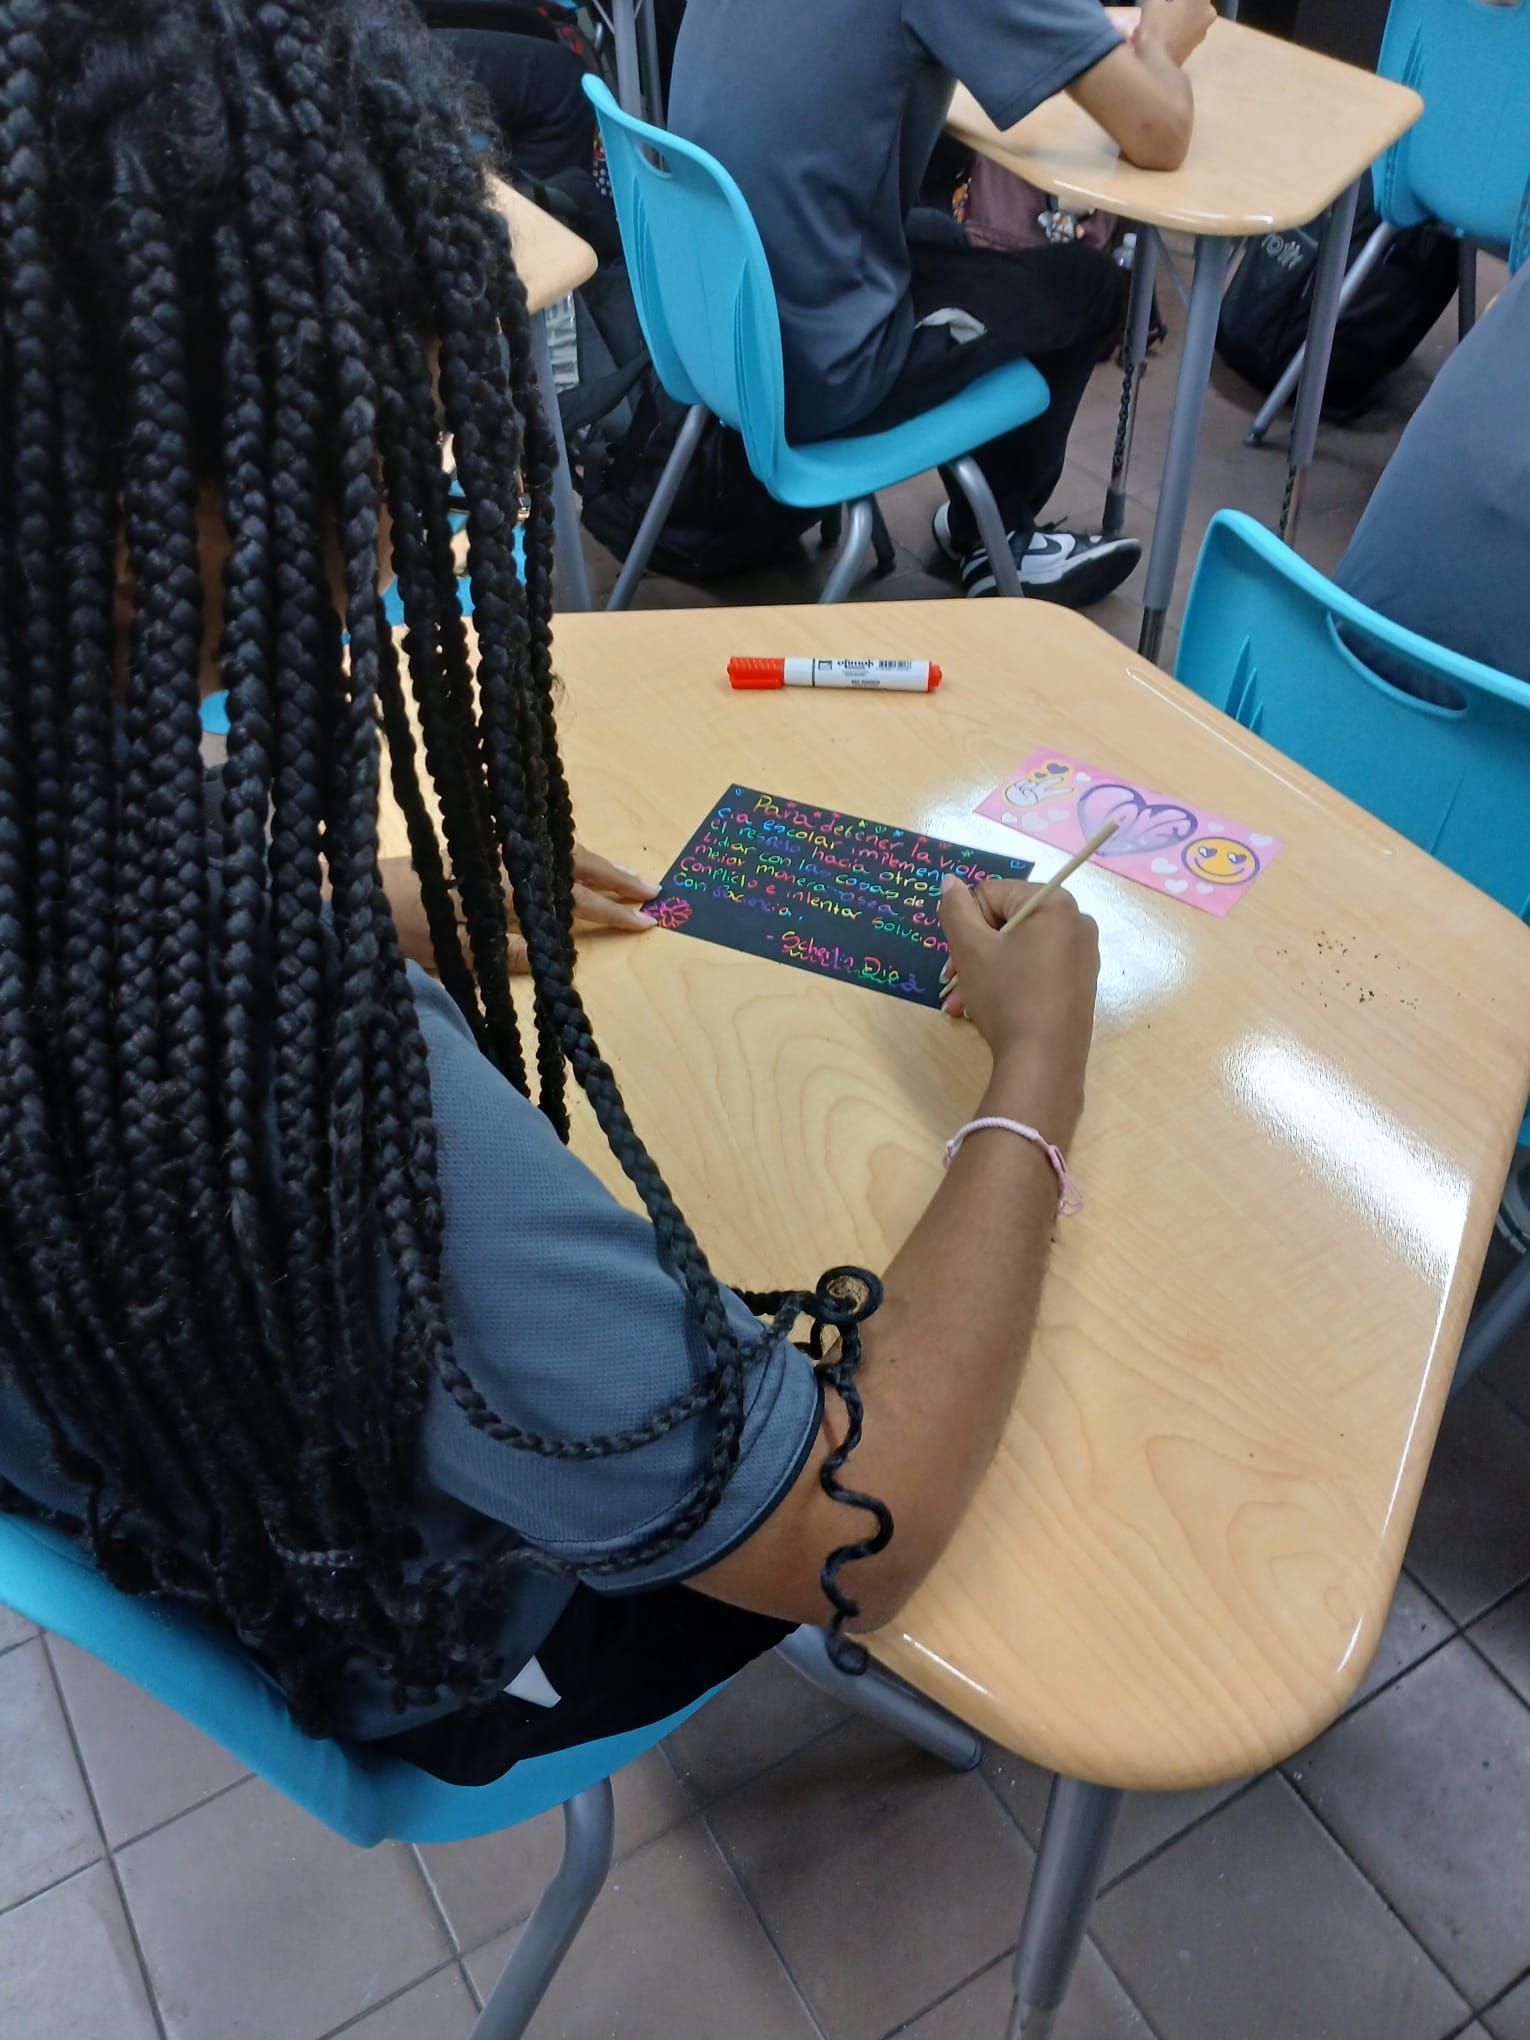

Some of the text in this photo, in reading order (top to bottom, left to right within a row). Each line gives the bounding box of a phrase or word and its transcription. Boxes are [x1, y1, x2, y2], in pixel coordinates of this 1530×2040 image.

[753, 795, 814, 829] Para
[820, 818, 904, 851] detener
[911, 839, 931, 865] la
[763, 819, 843, 850] escolar
[711, 819, 727, 834] el
[811, 846, 870, 875] hacia
[879, 871, 942, 897] otros
[765, 883, 776, 895] e
[903, 896, 925, 908] de
